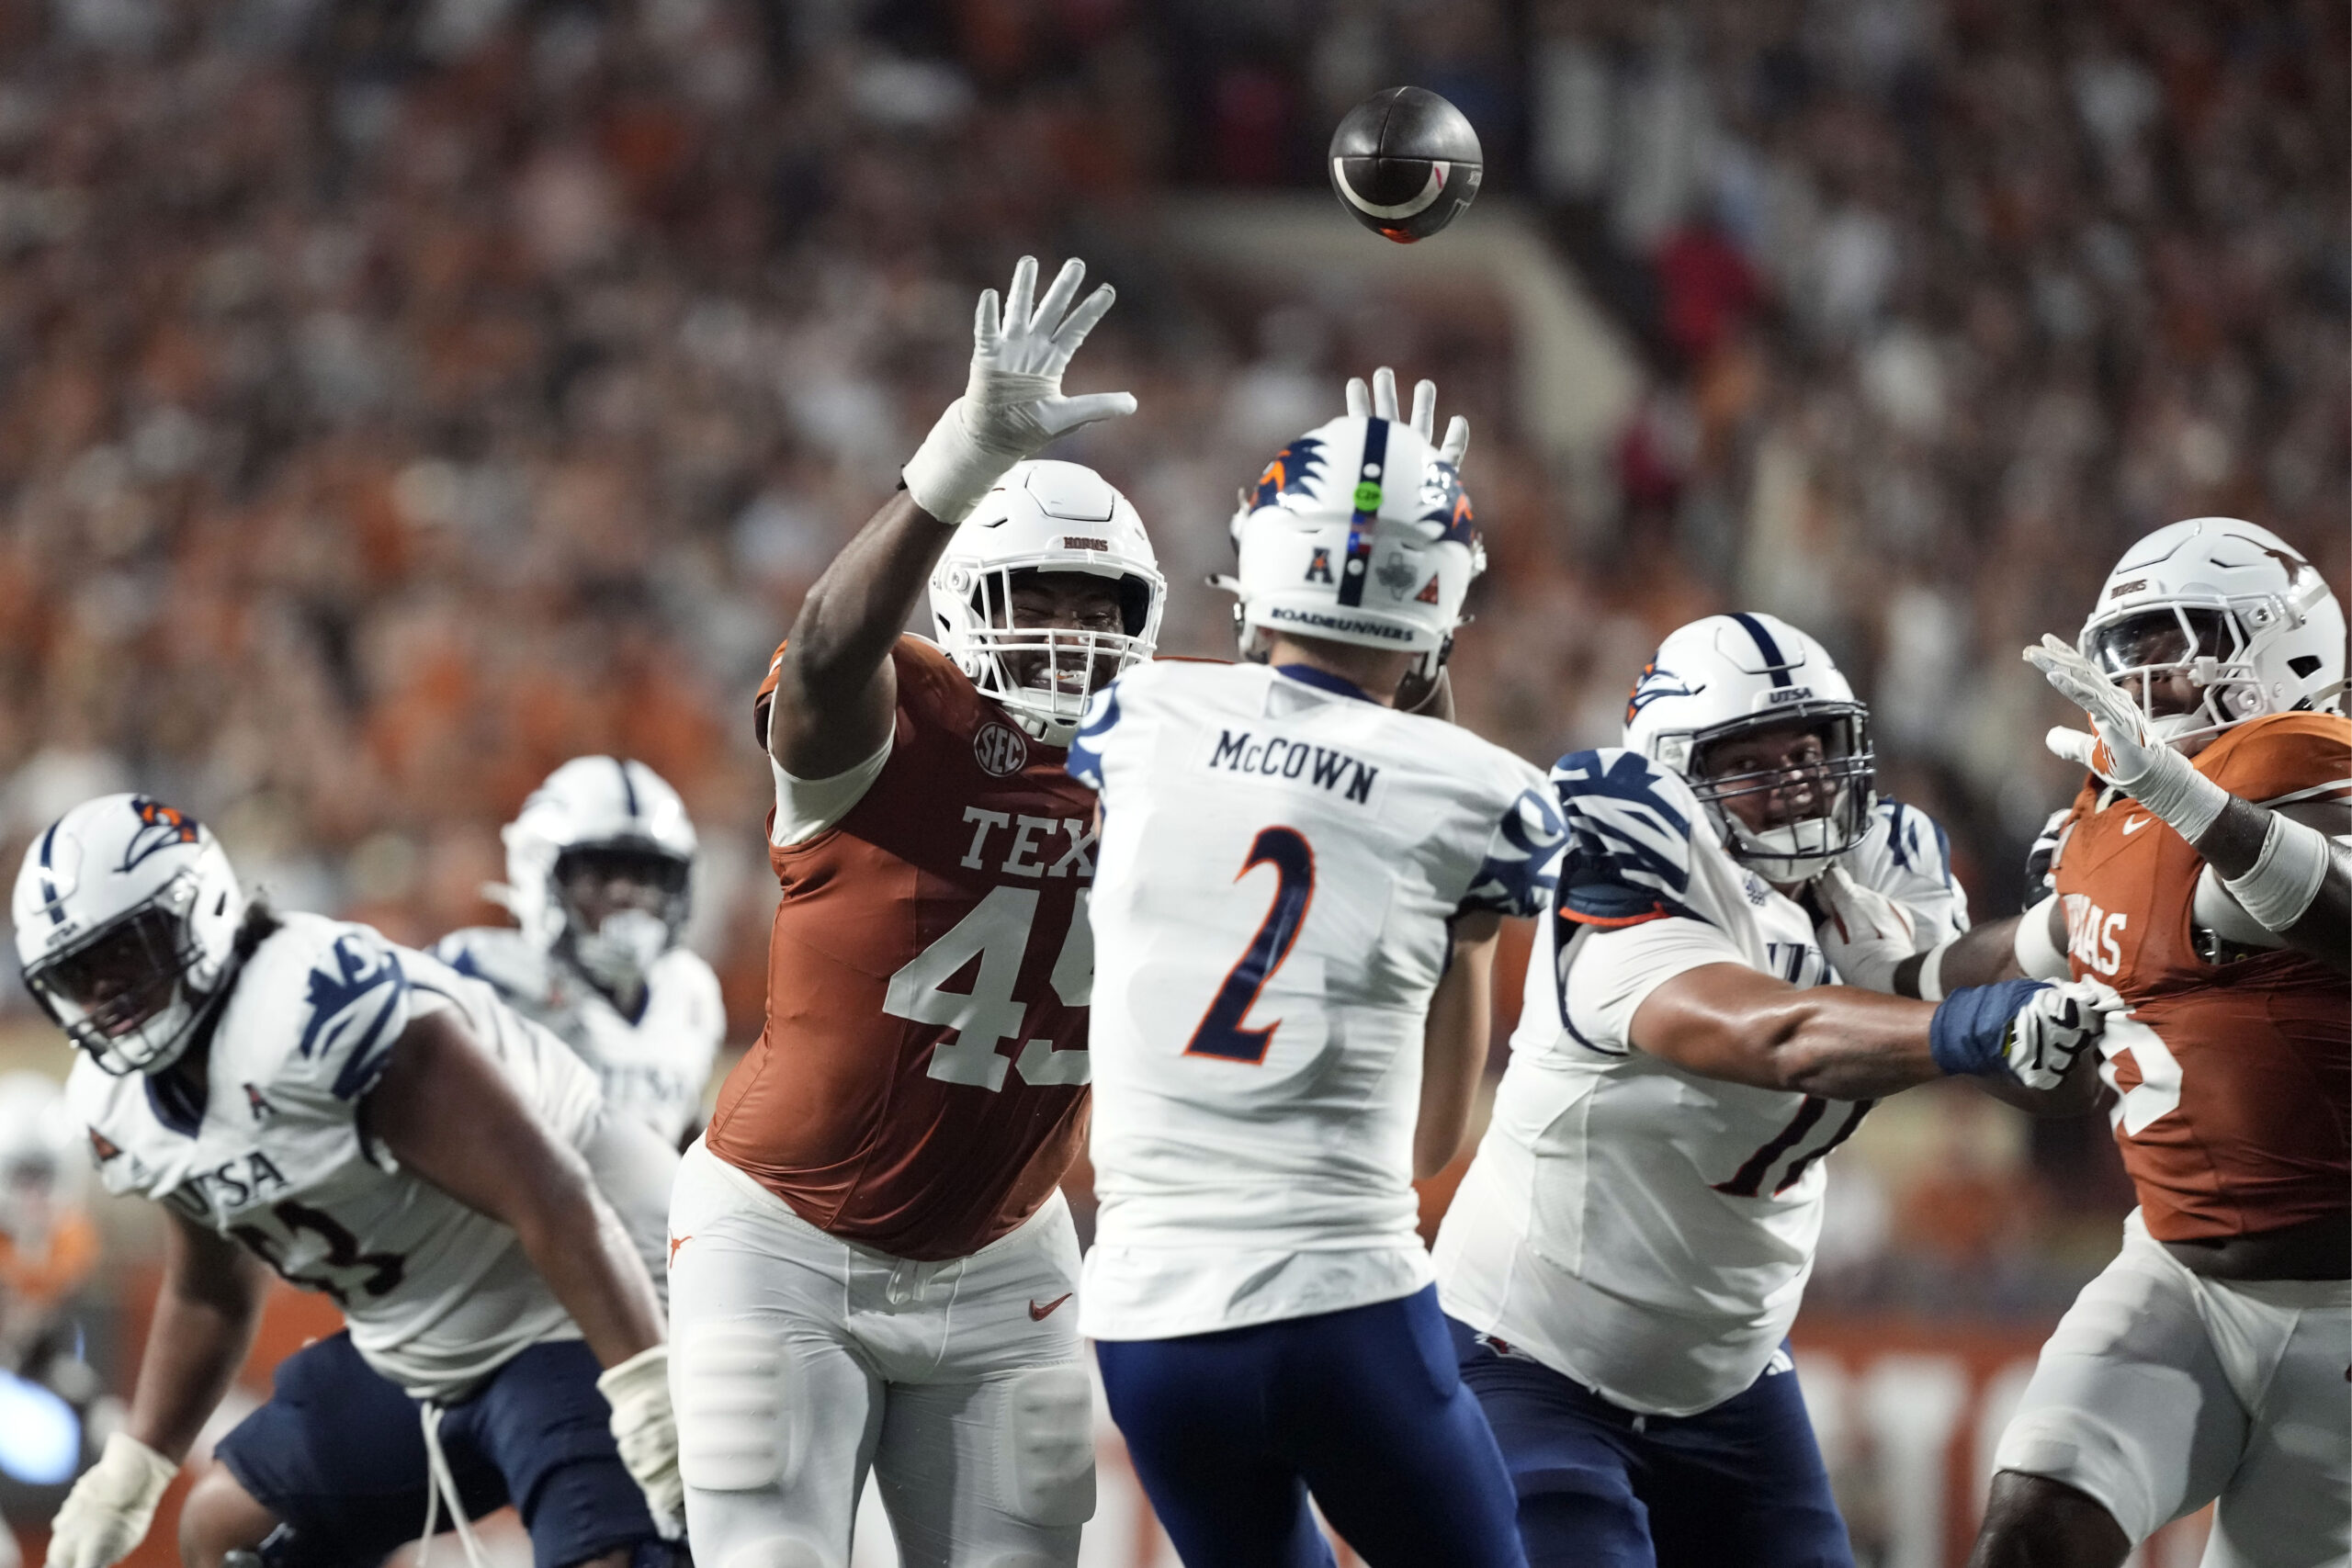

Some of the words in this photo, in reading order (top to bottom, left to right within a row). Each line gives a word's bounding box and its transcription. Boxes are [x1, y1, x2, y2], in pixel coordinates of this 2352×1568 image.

[1271, 607, 1414, 641] ROADRUNNERS
[1769, 686, 1814, 704] UTSA
[978, 725, 1022, 773] SEC
[1208, 729, 1379, 805] McCOWN
[1181, 825, 1316, 1066] 2
